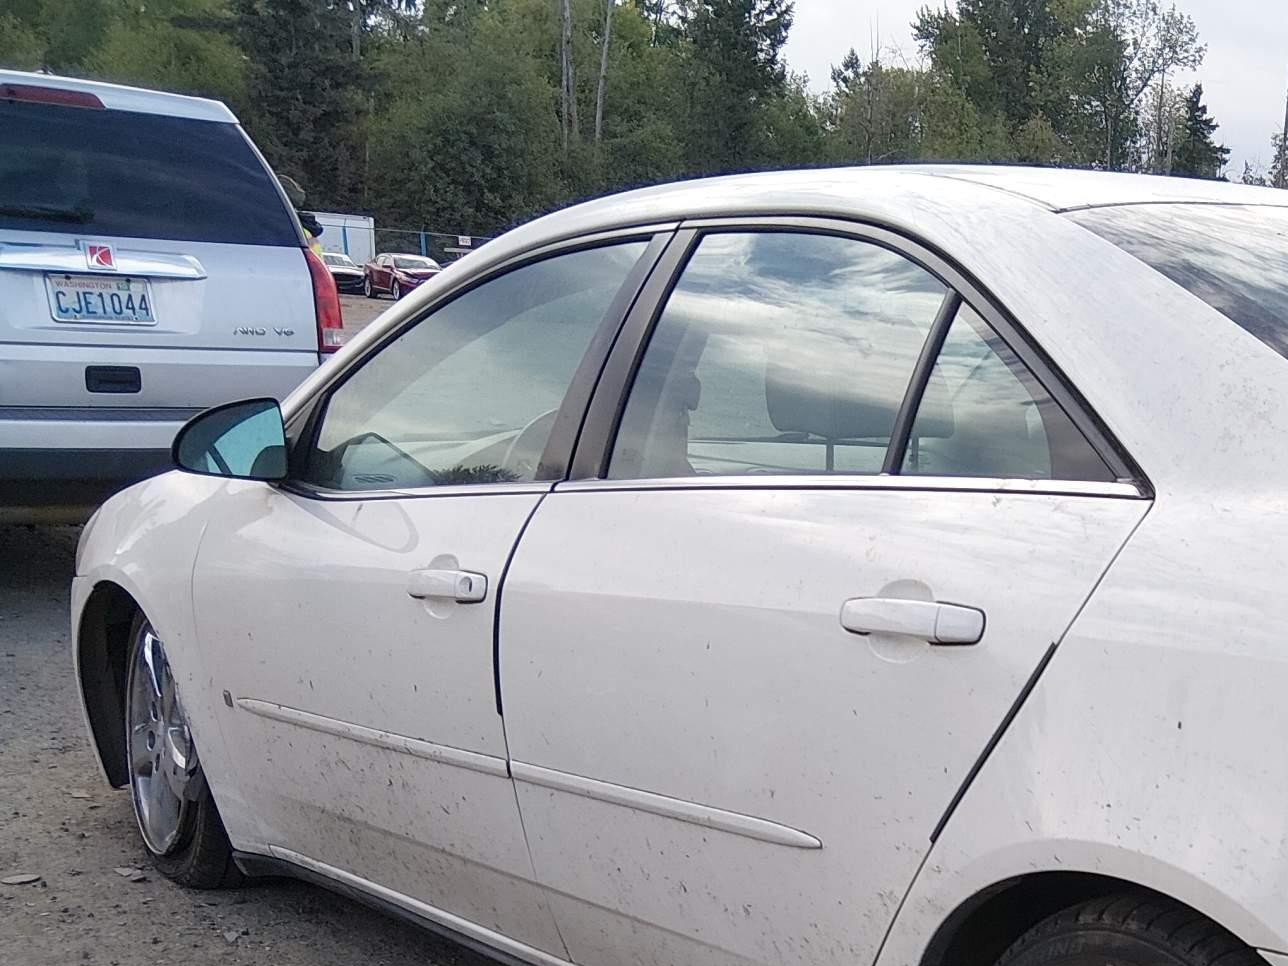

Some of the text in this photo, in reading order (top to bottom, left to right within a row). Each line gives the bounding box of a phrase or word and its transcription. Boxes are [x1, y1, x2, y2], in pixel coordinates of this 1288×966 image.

[55, 279, 112, 290] WASHINGTON
[55, 290, 150, 317] CJE1044
[272, 327, 295, 337] V6
